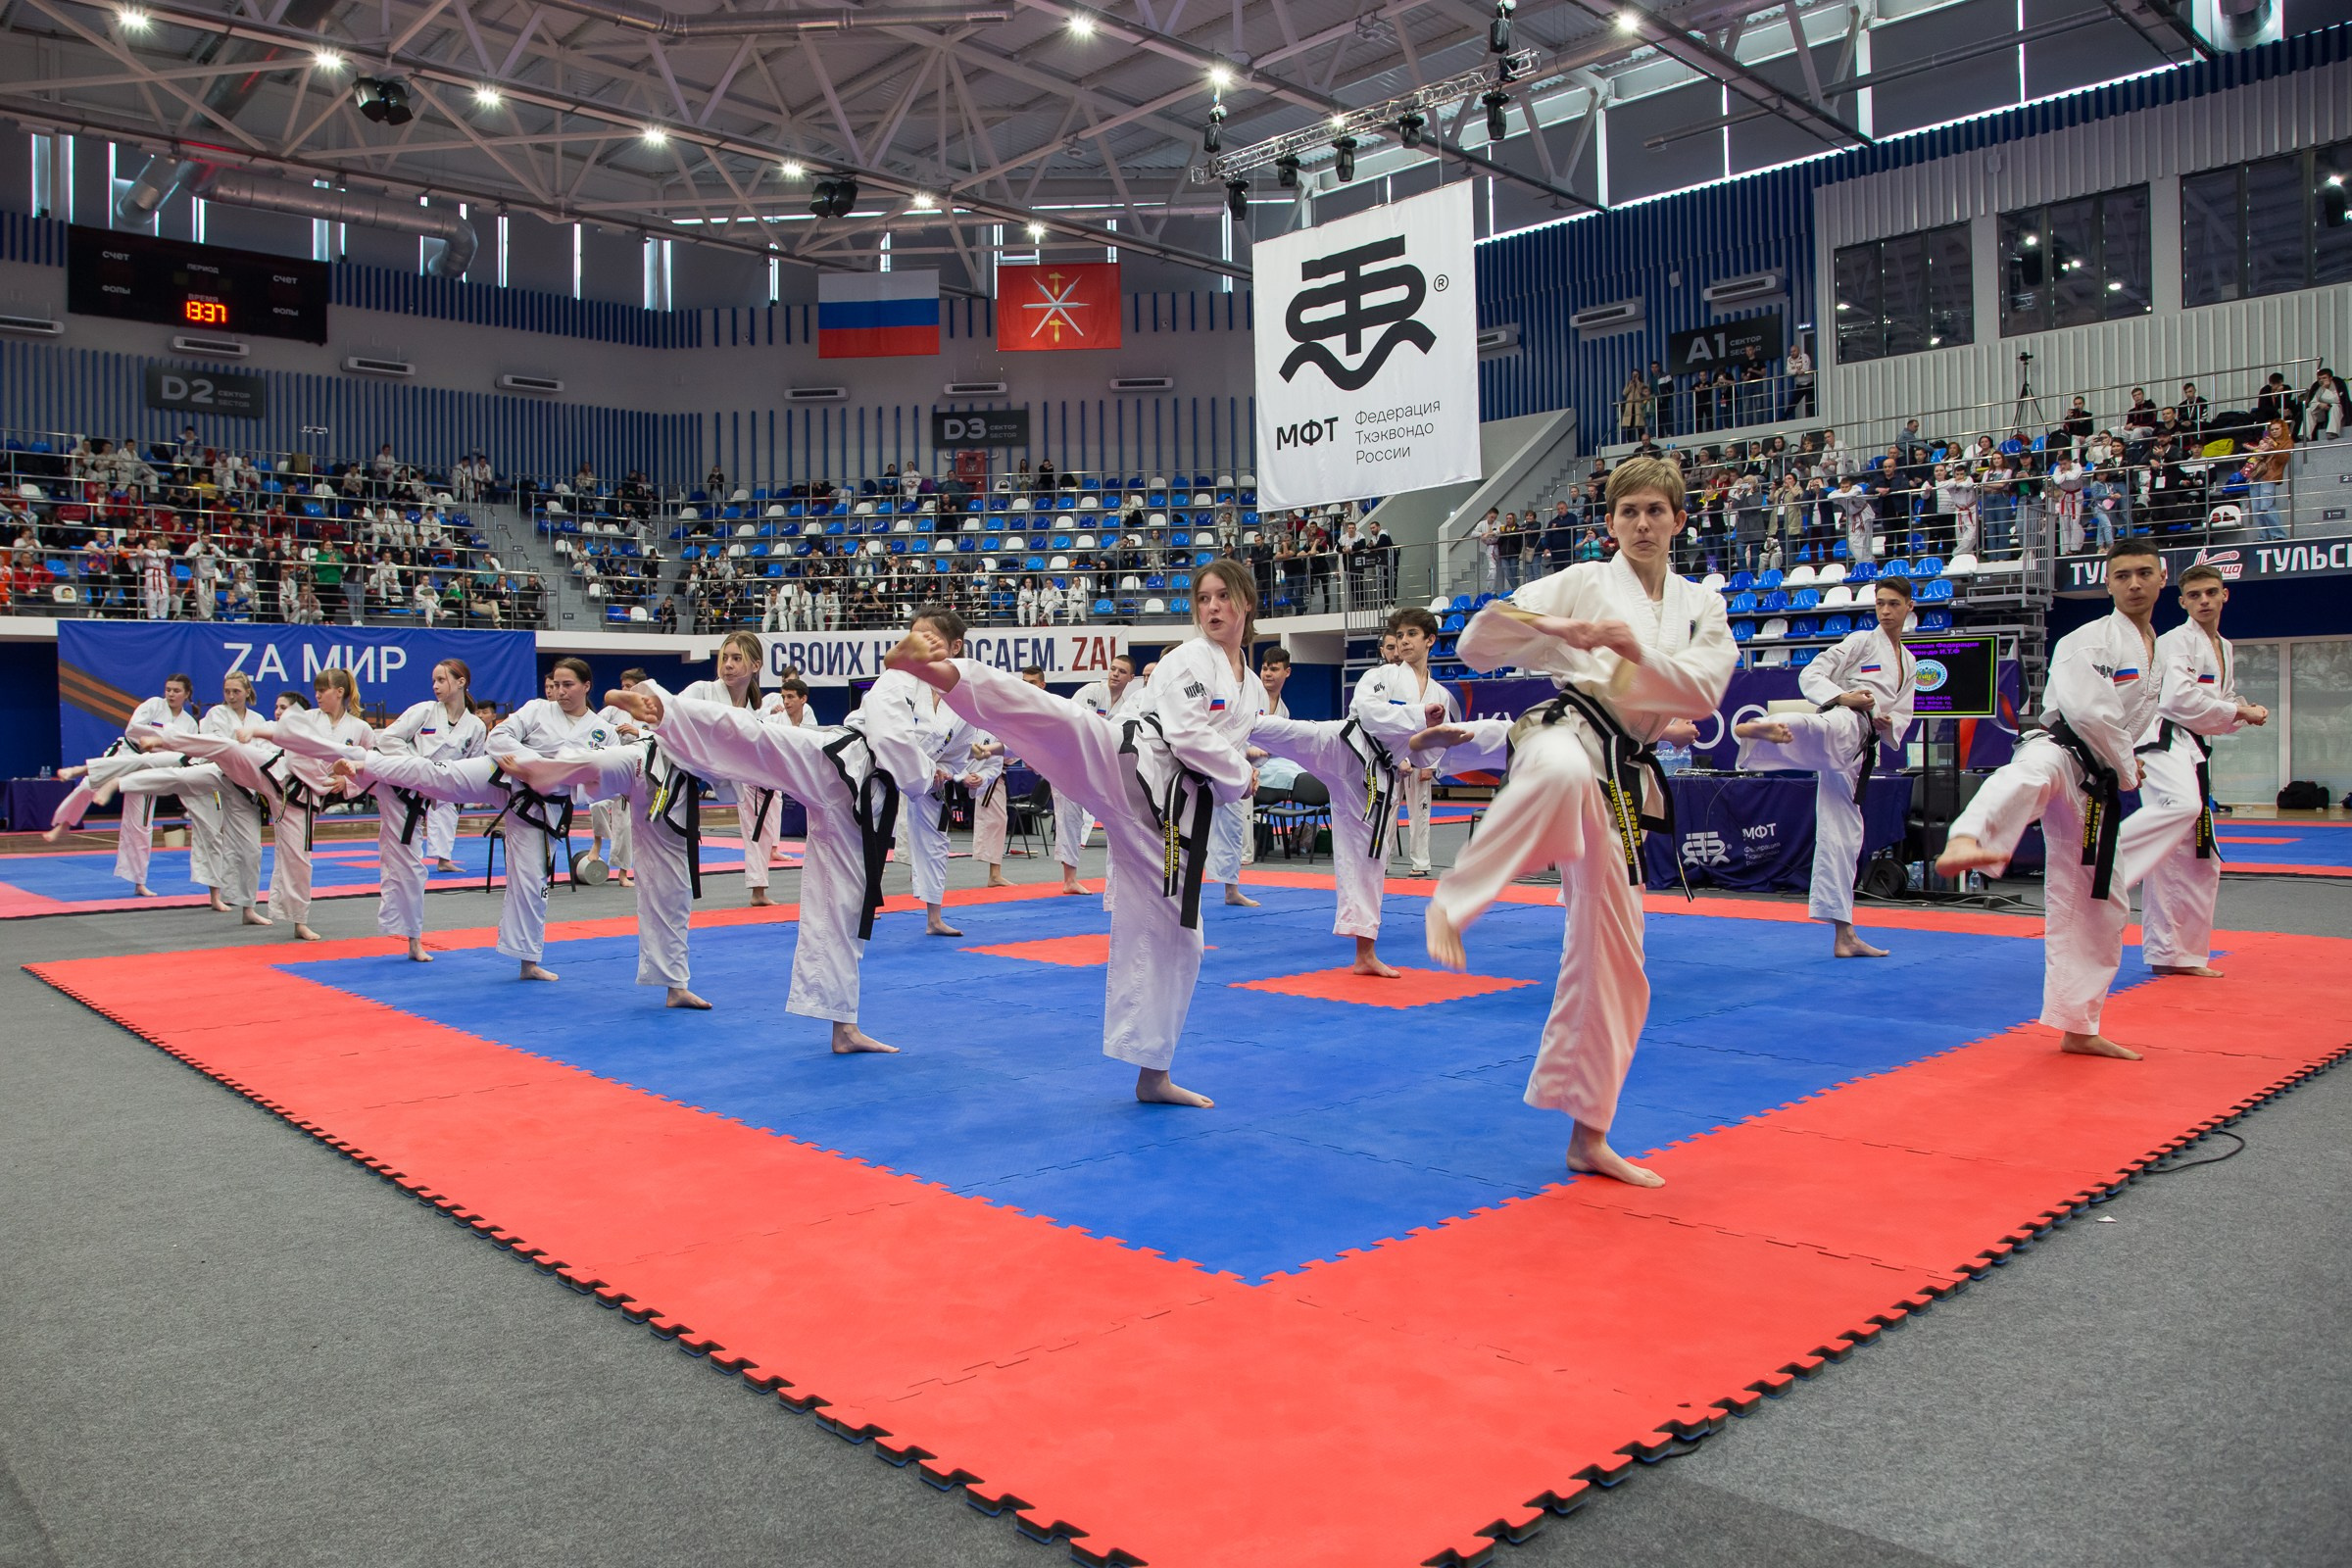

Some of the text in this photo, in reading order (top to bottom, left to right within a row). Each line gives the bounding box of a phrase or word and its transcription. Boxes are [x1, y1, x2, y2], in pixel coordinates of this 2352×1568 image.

[187, 263, 220, 275] ПЕРИОД
[101, 284, 131, 295] ФОЛЫ
[188, 293, 220, 303] ВРЕМЯ
[186, 301, 226, 322] 13:37
[272, 307, 299, 317] ФОЛЫ
[1686, 332, 1725, 365] A1
[1730, 335, 1762, 346] СЕКТОР
[162, 375, 215, 404] D2
[218, 390, 251, 399] СЕКТОР
[218, 399, 250, 408] SECTOR
[1354, 400, 1441, 425] Федерация
[944, 417, 987, 440] D3
[1276, 416, 1339, 451] МФТ
[1355, 422, 1434, 445] Тхэквондо
[1356, 446, 1410, 465] России
[1354, 556, 1366, 566] E1
[303, 643, 407, 683] МИР
[770, 640, 865, 676] СВОИХ
[1608, 779, 1634, 864] POPOVA ANASTASIYA
[1742, 823, 1777, 840] МФТ
